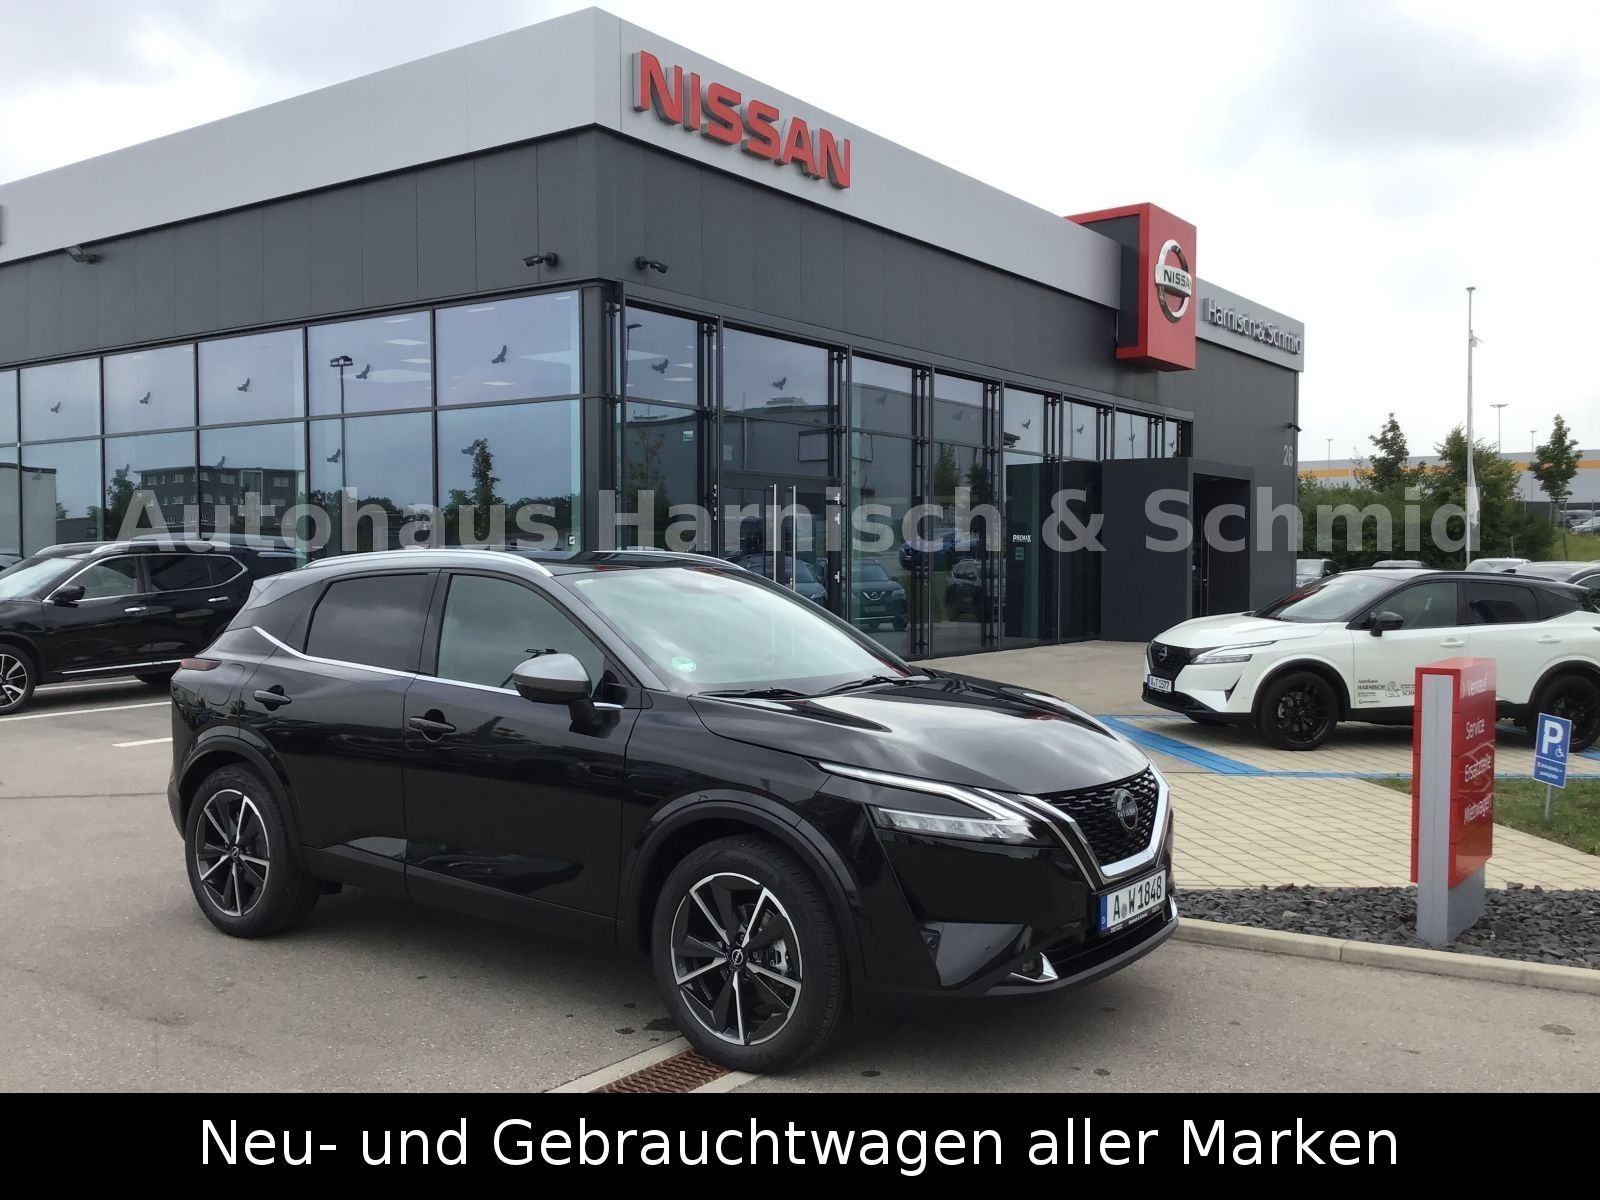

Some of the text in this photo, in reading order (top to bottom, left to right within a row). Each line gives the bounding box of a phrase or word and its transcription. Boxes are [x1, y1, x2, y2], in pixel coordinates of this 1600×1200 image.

[633, 50, 850, 189] NISSAN
[1163, 269, 1191, 290] NISSA
[1208, 299, 1255, 338] Harnisch
[1267, 323, 1302, 354] Schmid
[1283, 444, 1293, 466] 26
[1465, 716, 1485, 740] Service
[1542, 719, 1564, 754] P
[1463, 792, 1493, 826] Mietwagen
